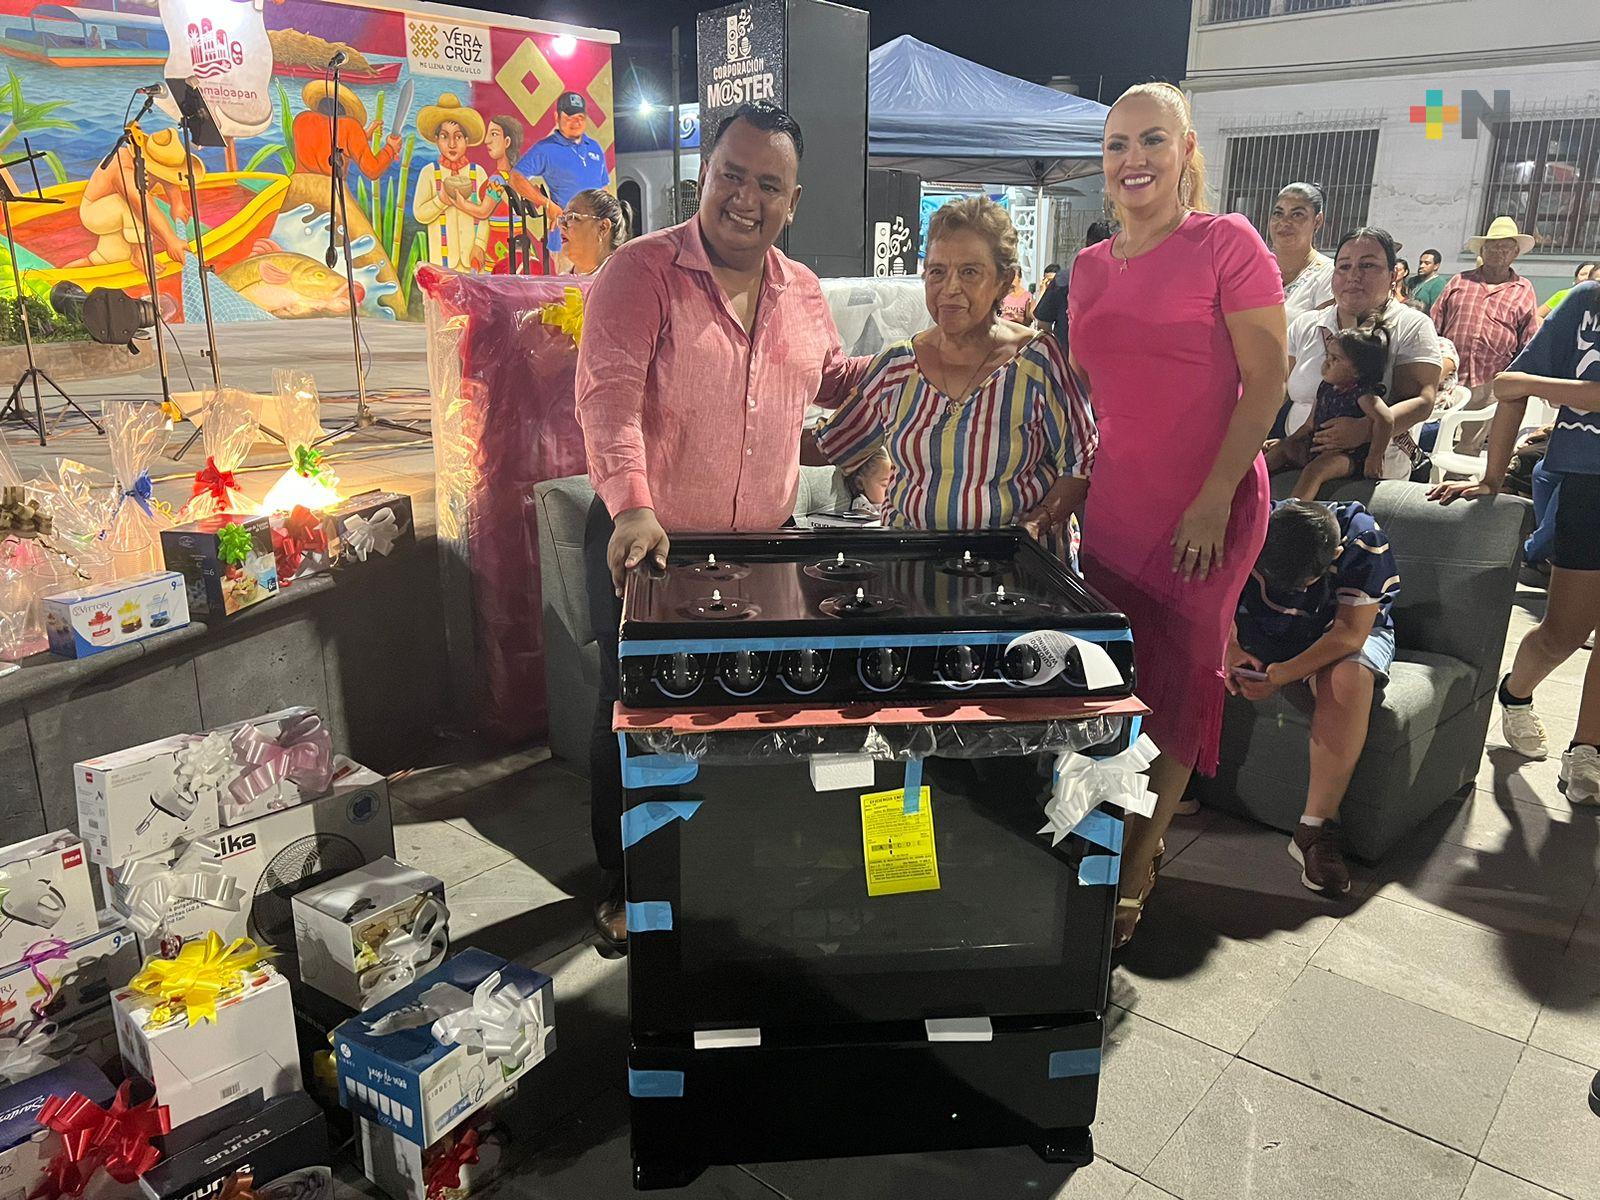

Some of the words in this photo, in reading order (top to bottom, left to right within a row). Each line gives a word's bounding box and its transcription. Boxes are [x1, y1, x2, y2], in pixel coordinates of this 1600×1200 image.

[442, 27, 483, 49] VERA
[444, 45, 482, 65] CRUZ
[428, 62, 445, 70] LLENA
[453, 66, 482, 75] ORGULLO
[713, 57, 764, 81] CORPORACIÓN
[707, 73, 775, 108] M@STER
[171, 581, 177, 591] 9
[214, 833, 256, 857] ika
[63, 853, 81, 864] RCA
[113, 935, 122, 949] 9
[203, 1128, 272, 1165] taurus
